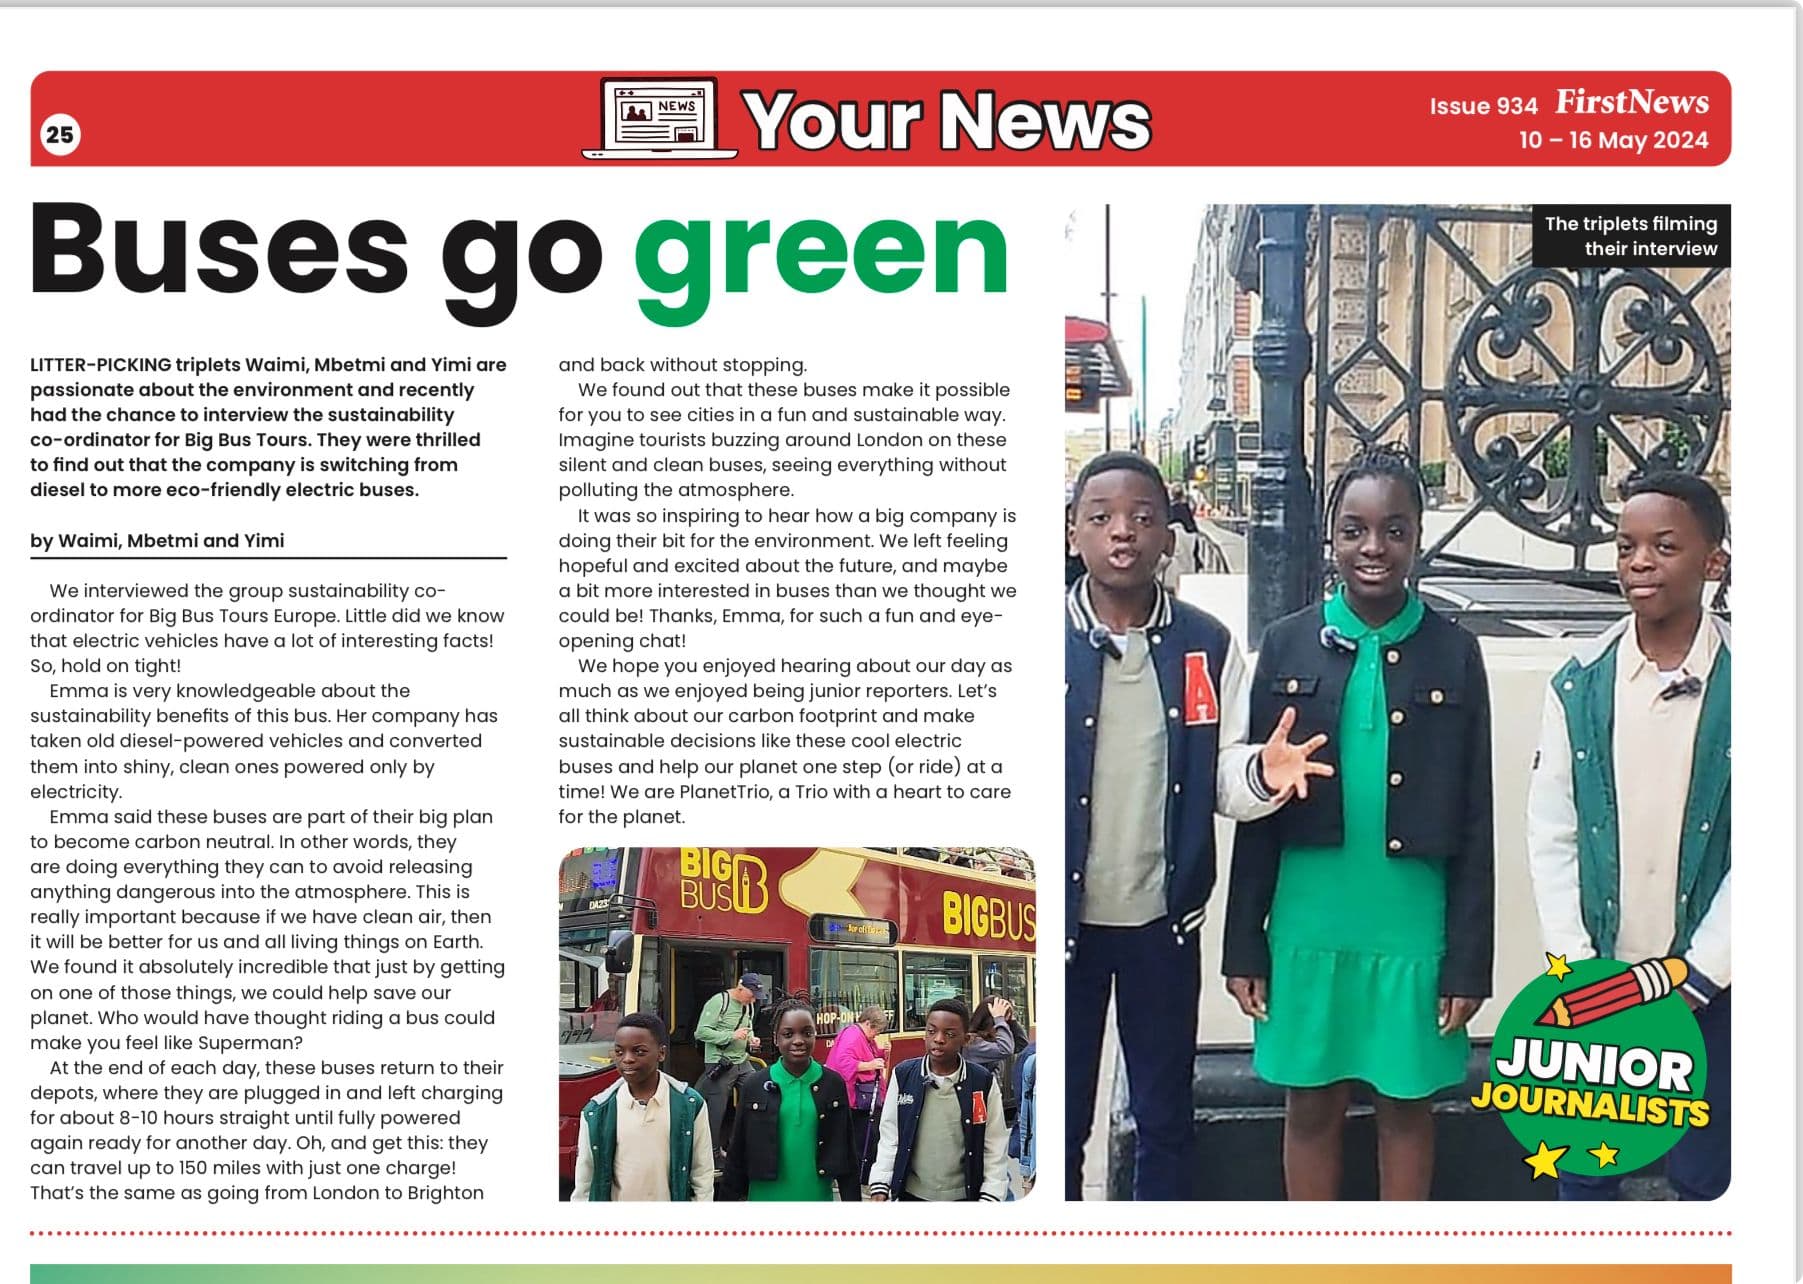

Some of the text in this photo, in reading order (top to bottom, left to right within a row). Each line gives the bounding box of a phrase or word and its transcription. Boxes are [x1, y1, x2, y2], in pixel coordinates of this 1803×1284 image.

[658, 100, 696, 112] NEWS
[1431, 87, 1710, 115] Issue 934 FirstNews
[739, 90, 1152, 152] Your News
[46, 125, 74, 144] 25
[1519, 130, 1543, 149] 10
[1570, 130, 1592, 149] 16
[1599, 131, 1648, 155] May
[1653, 130, 1709, 149] 2024
[1545, 215, 1718, 236] The triplets filming
[1585, 240, 1718, 256] their interview
[32, 201, 1008, 329] Buses go green
[30, 356, 507, 377] LITTER-PICKING triplets Waimi, Mbetmi and Yimi are
[30, 381, 475, 402] passionate about the environment and recently
[30, 406, 455, 427] had the chance to interview the sustainability
[30, 431, 481, 452] co-ordinator for Big Bus Tours. They were thrilled
[559, 431, 1007, 452] Imagine tourists buzzing around London on these
[30, 456, 458, 477] to find out that the company is switching from
[30, 481, 419, 502] diesel to more eco-friendly electric buses.
[30, 532, 285, 553] by Waimi, Mbetmi and Yimi
[559, 557, 1008, 578] hopeful and excited about the future, and maybe
[49, 582, 446, 603] We interviewed the group sustainability co-
[30, 657, 181, 678] So, hold on tight!
[559, 682, 997, 703] much as we enjoyed being junior reporters. Let’s
[1184, 651, 1219, 726] A
[30, 732, 482, 753] taken old diesel-powered vehicles and converted
[559, 732, 962, 748] sustainable decisions like these cool electric
[30, 783, 122, 804] electricity.
[30, 858, 473, 879] are doing everything they can to avoid releasing
[680, 846, 732, 882] BIG
[680, 879, 733, 912] BUS
[1495, 1036, 1694, 1092] JUNIOR
[30, 1084, 503, 1105] depots, where they are plugged in and left charging
[1471, 1081, 1711, 1128] JOURNALISTS
[30, 1184, 484, 1205] That’s the same as going from London to Brighton
